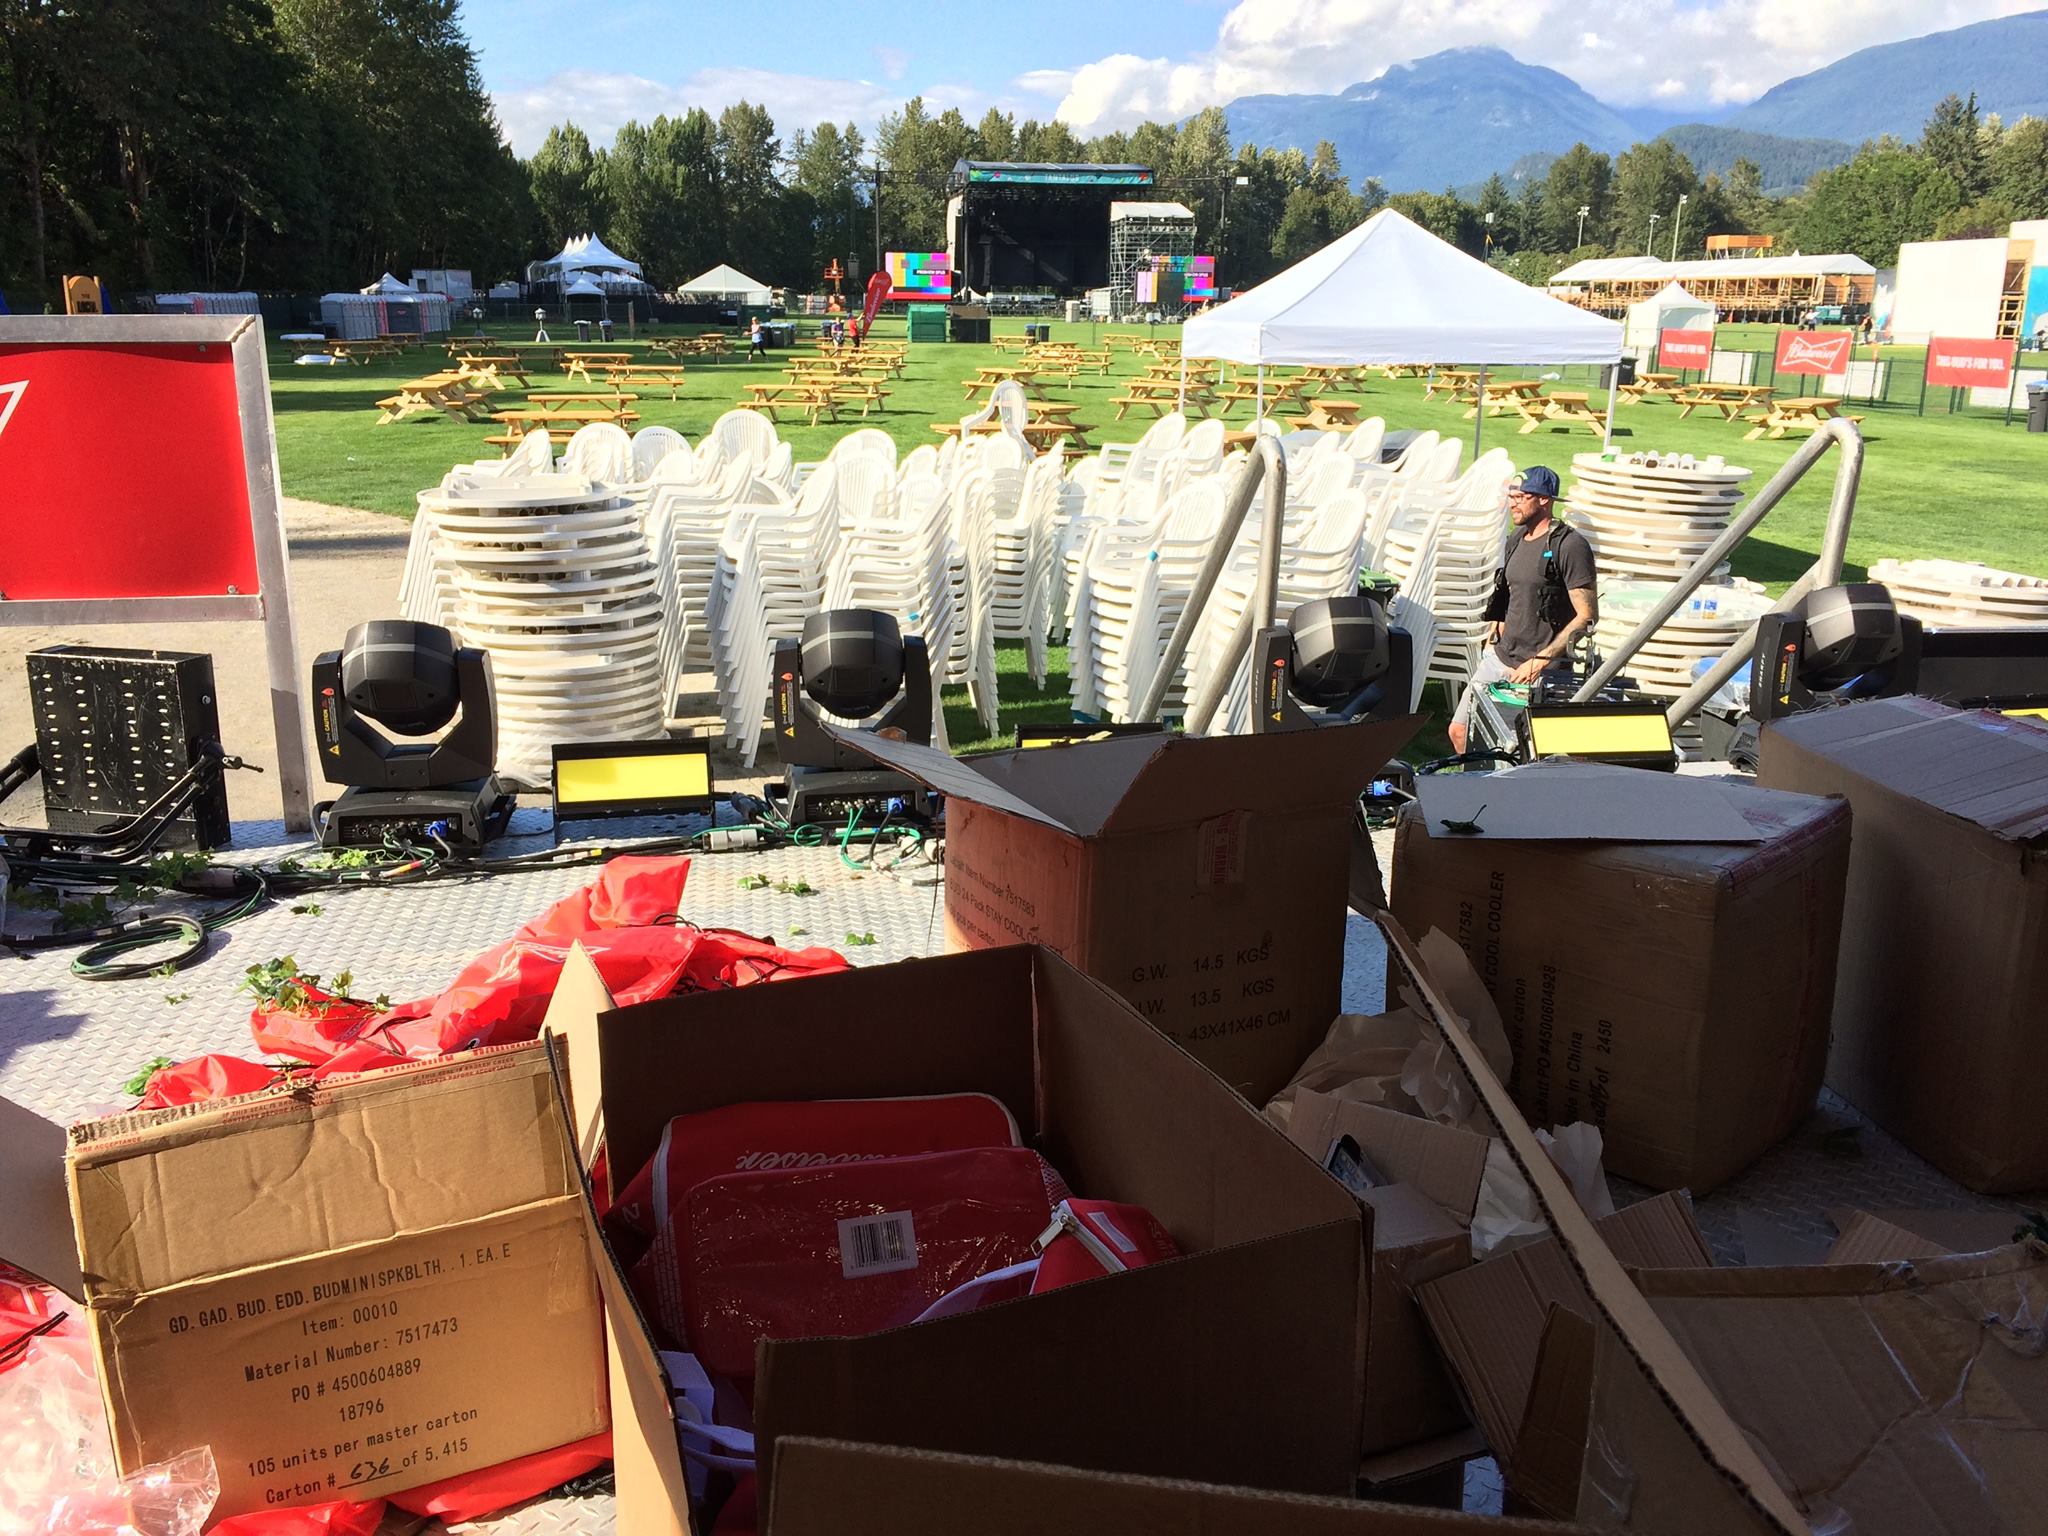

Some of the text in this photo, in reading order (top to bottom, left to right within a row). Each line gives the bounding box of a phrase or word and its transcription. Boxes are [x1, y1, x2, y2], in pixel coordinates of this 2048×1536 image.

[1488, 871, 1504, 932] COOLER
[1004, 918, 1026, 941] COOL
[1460, 901, 1473, 955] 517582
[1132, 945, 1270, 982] G.W. 14.5 KGS
[1485, 933, 1501, 976] COOL
[1190, 988, 1221, 1007] 13.5
[1242, 978, 1275, 998] KGS
[1514, 978, 1526, 1022] carton
[1189, 1014, 1263, 1042] 43X41X46
[1267, 1010, 1291, 1028] CM
[1596, 1019, 1612, 1054] 2450
[1538, 1056, 1550, 1078] PO
[1567, 1031, 1583, 1073] China
[1566, 1079, 1580, 1092] in
[302, 1300, 399, 1336] Item: 00010
[245, 1317, 459, 1382] Material Number: 7517473
[291, 1358, 422, 1403] PO # 4500604889
[339, 1398, 385, 1422] 18796
[247, 1407, 478, 1477] 105 units per master carton
[266, 1479, 322, 1504] Carton
[326, 1473, 337, 1488] #
[401, 1447, 419, 1470] of
